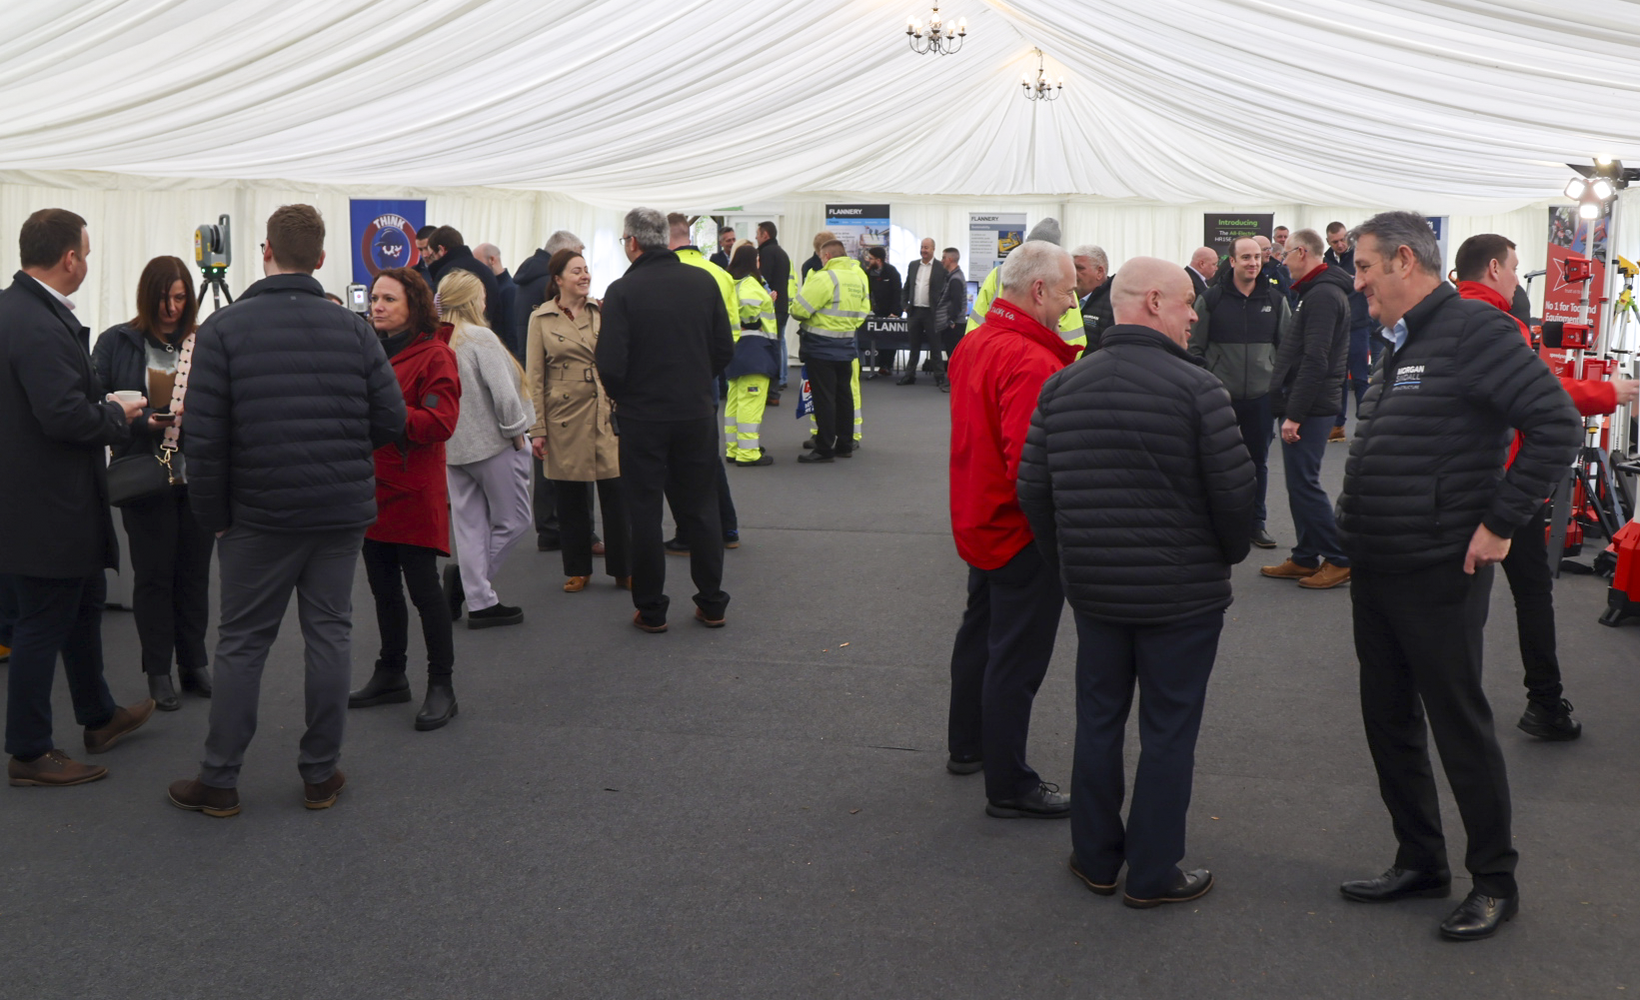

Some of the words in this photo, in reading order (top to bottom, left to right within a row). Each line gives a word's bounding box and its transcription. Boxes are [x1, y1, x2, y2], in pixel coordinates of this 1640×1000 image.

[373, 215, 405, 229] THINK
[1218, 219, 1258, 227] Introducing
[1545, 301, 1554, 311] No
[1554, 302, 1559, 311] 1
[1559, 302, 1570, 312] for
[1397, 365, 1425, 375] MORGAN
